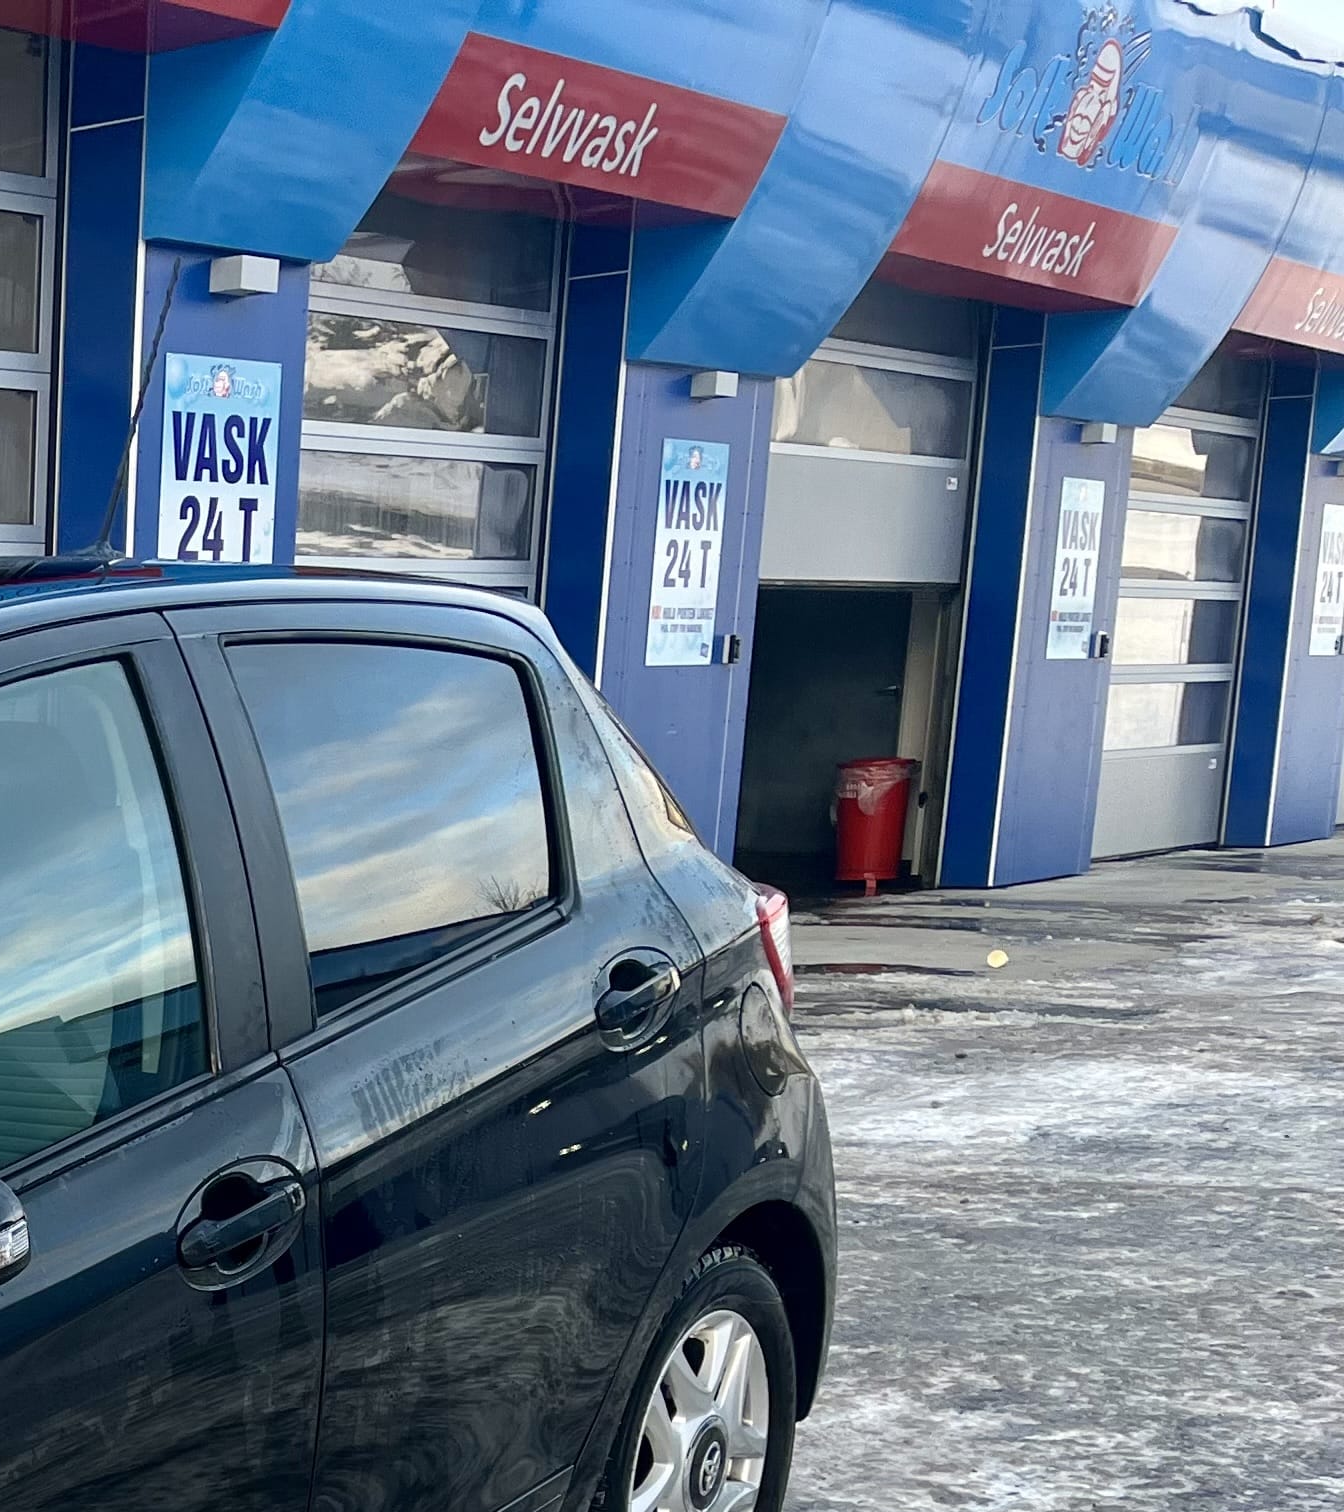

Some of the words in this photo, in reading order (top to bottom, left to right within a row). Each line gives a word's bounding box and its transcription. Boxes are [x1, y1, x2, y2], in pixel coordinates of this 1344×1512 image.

[478, 72, 659, 177] Selvvask
[982, 202, 1097, 277] Selvvask
[172, 411, 272, 485] VASK
[177, 495, 224, 562] 24
[239, 497, 258, 563] T
[664, 479, 722, 531] VASK
[1062, 510, 1099, 551] VASK
[1323, 531, 1344, 565] VAS
[663, 539, 691, 588] 24
[700, 540, 712, 588] T
[1059, 557, 1078, 597] 24
[1083, 558, 1091, 597] T
[1320, 571, 1333, 603] 24
[1335, 571, 1343, 604] T
